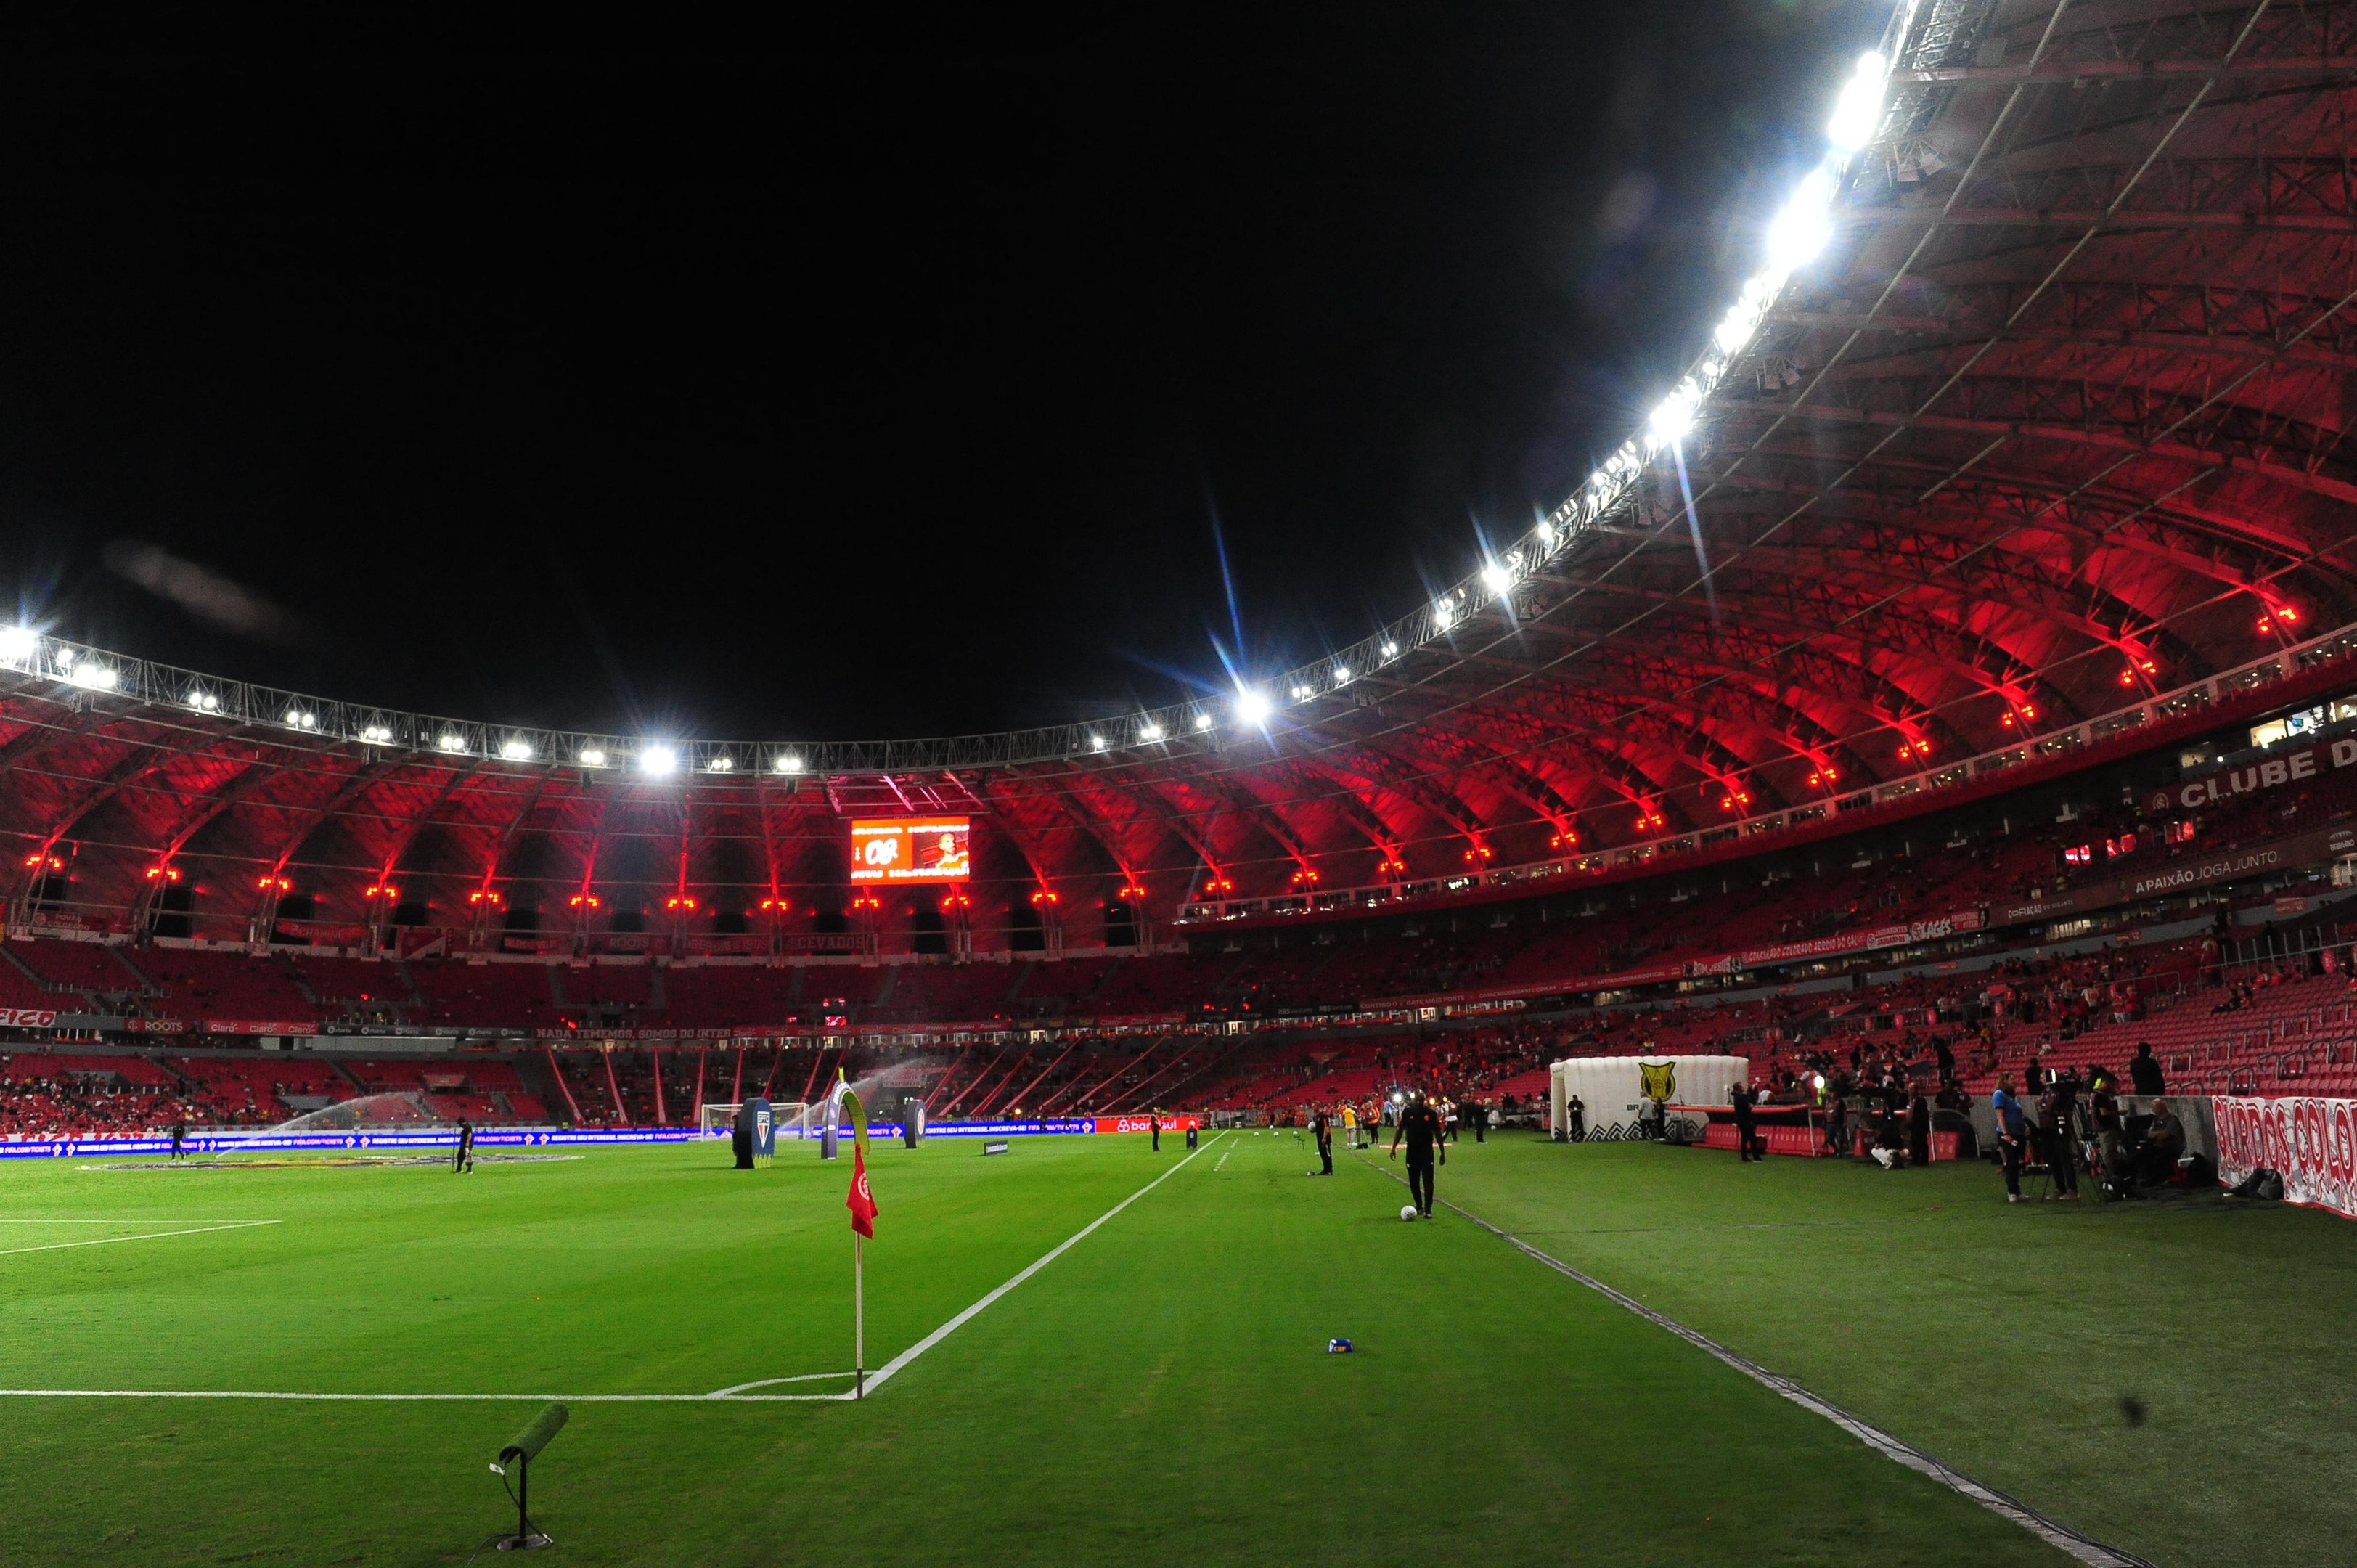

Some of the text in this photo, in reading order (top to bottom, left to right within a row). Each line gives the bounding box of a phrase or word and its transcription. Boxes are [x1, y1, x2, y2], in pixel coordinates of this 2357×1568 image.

[2181, 751, 2316, 808] CLUBE
[2136, 851, 2281, 894] A PAIXÃO JOGA JUNTO.
[145, 1021, 184, 1032] ROOTS
[249, 1024, 274, 1034] Claro
[287, 1024, 312, 1034] Claro
[536, 1028, 731, 1039] NADA TEMEMOS, SOMOS DO INTER
[2213, 1097, 2292, 1177] SURDOS
